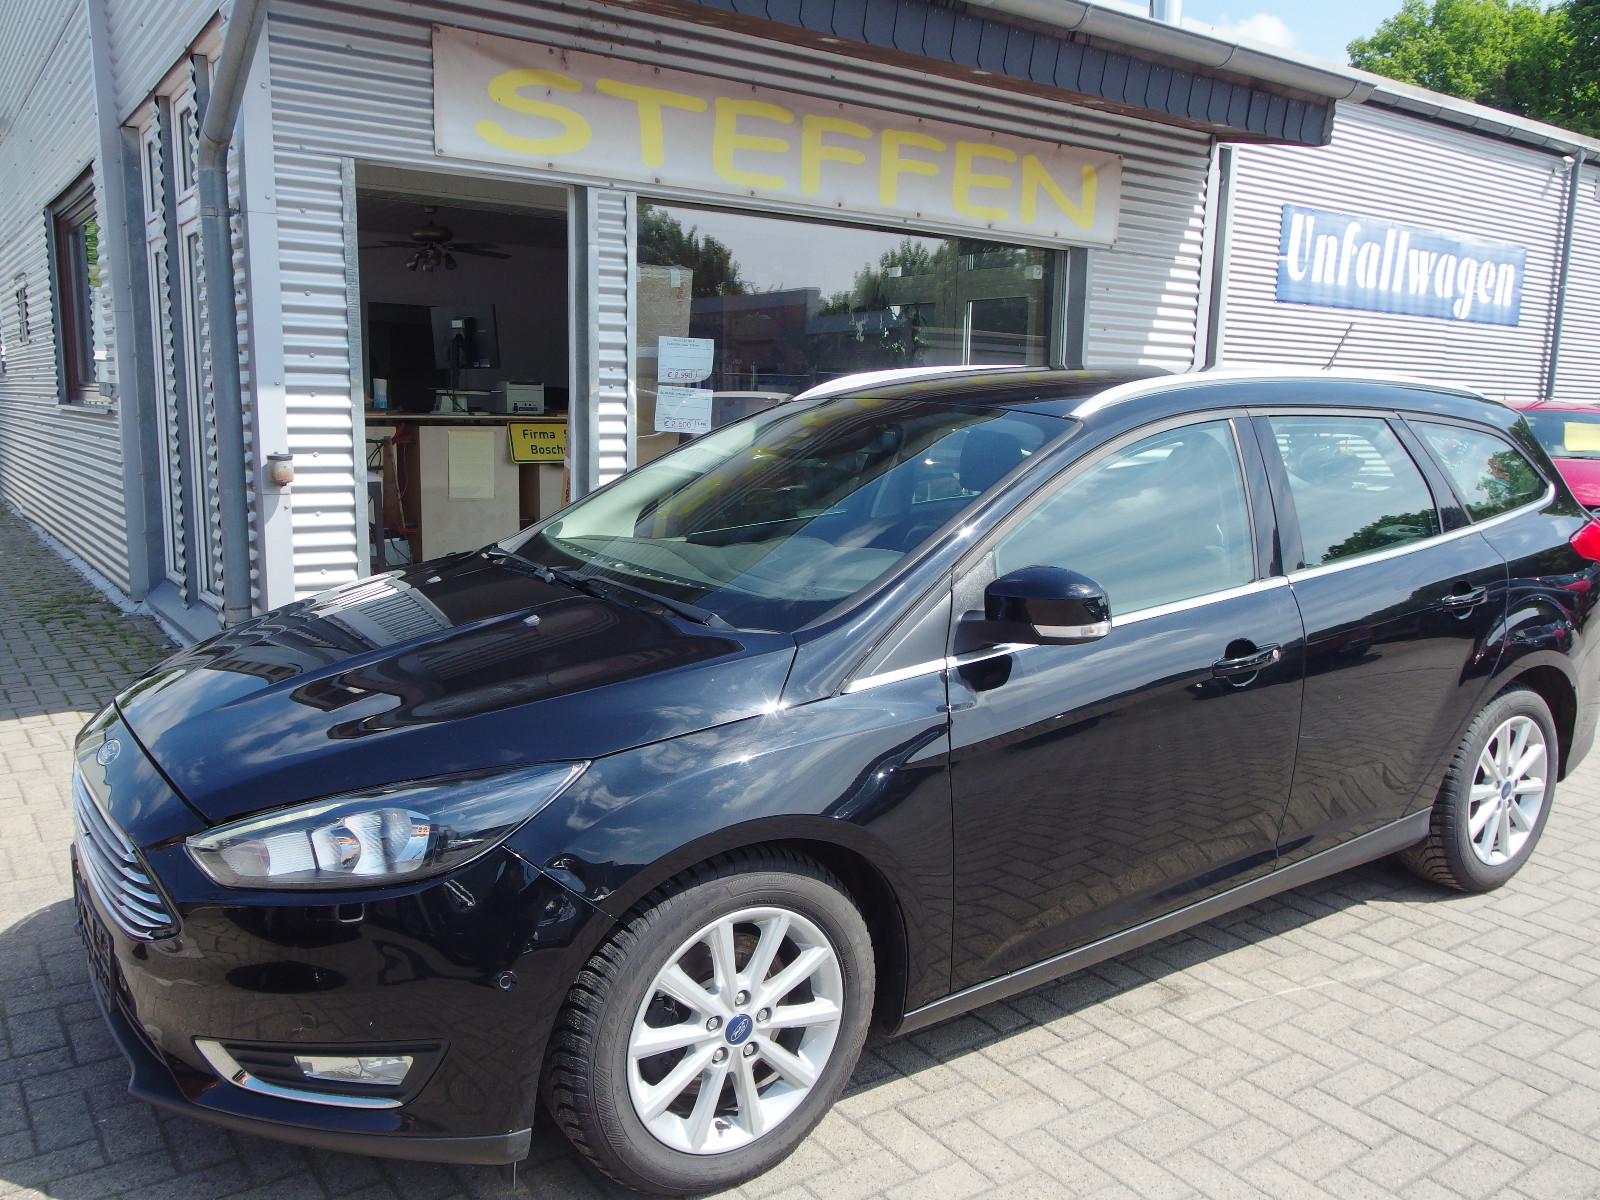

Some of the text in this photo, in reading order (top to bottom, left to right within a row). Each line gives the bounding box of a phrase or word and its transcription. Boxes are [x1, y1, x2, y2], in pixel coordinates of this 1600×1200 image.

[474, 67, 1096, 230] STEFFEN
[1287, 213, 1516, 319] Unfallwagen
[523, 429, 555, 439] Firma
